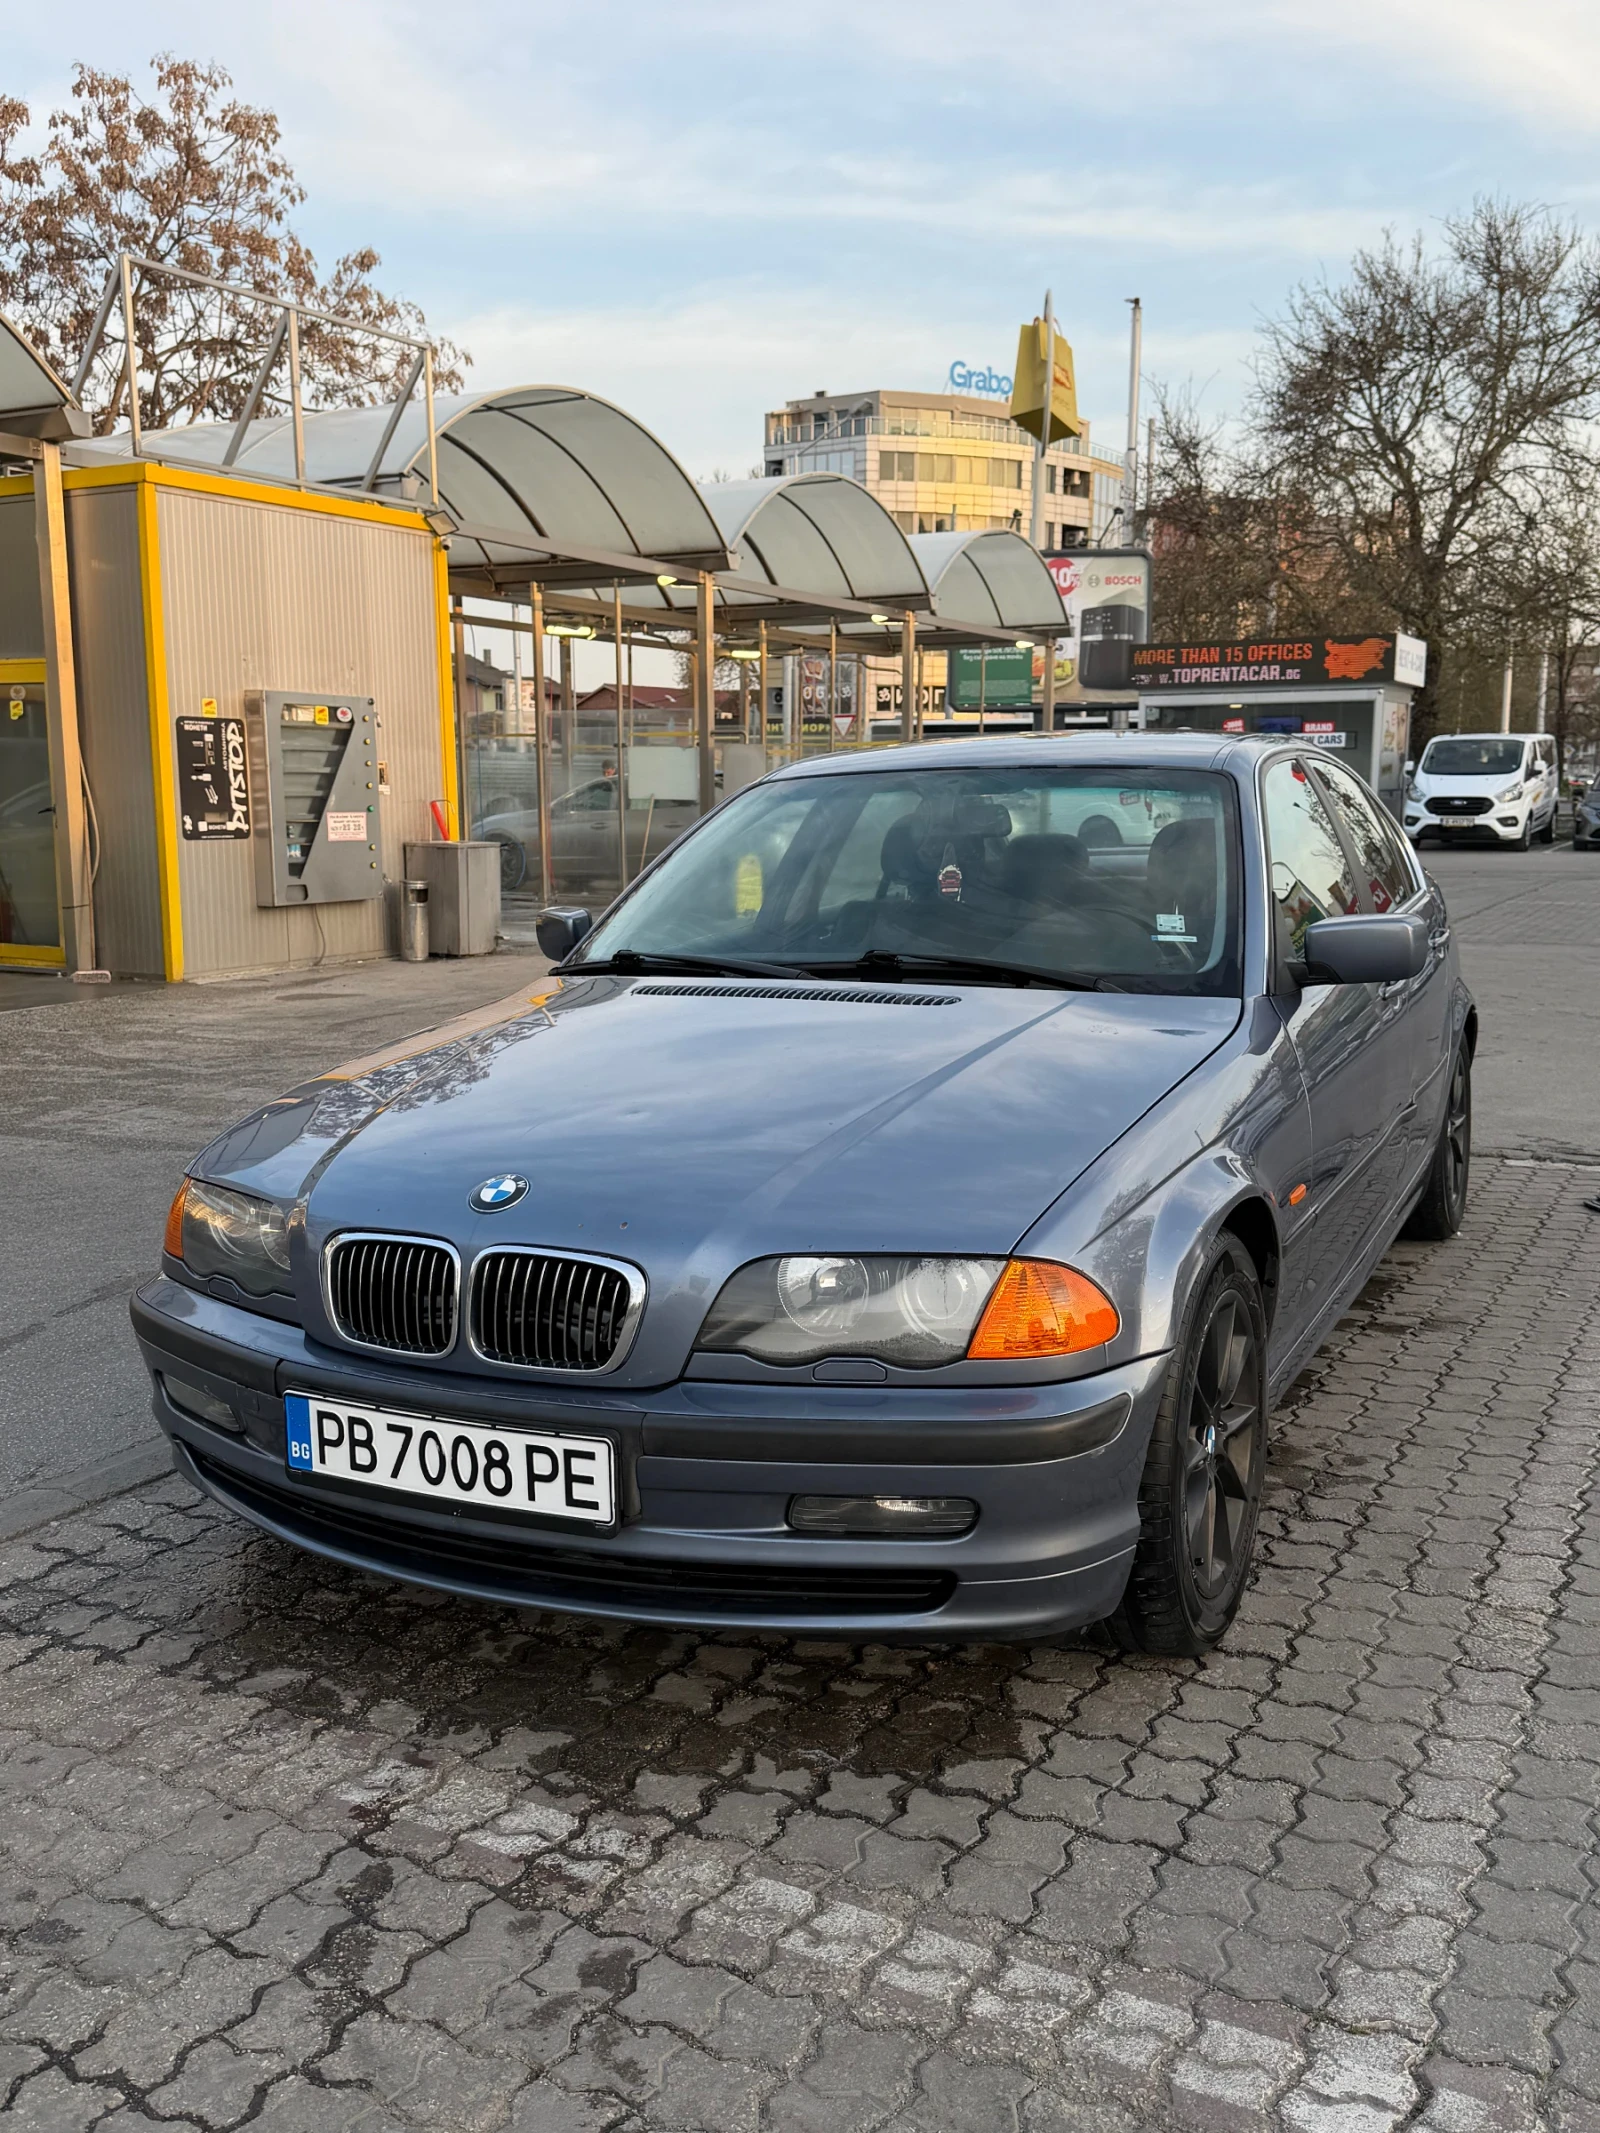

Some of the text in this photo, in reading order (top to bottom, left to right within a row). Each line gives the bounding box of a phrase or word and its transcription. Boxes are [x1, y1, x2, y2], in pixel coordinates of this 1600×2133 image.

[949, 360, 1013, 395] Grabo
[1104, 576, 1142, 586] BOSCH
[1134, 643, 1313, 665] MORE THAN 15 OFFICES
[1304, 723, 1333, 732] BRAND
[1317, 734, 1342, 745] CARS
[291, 1440, 310, 1460] BG
